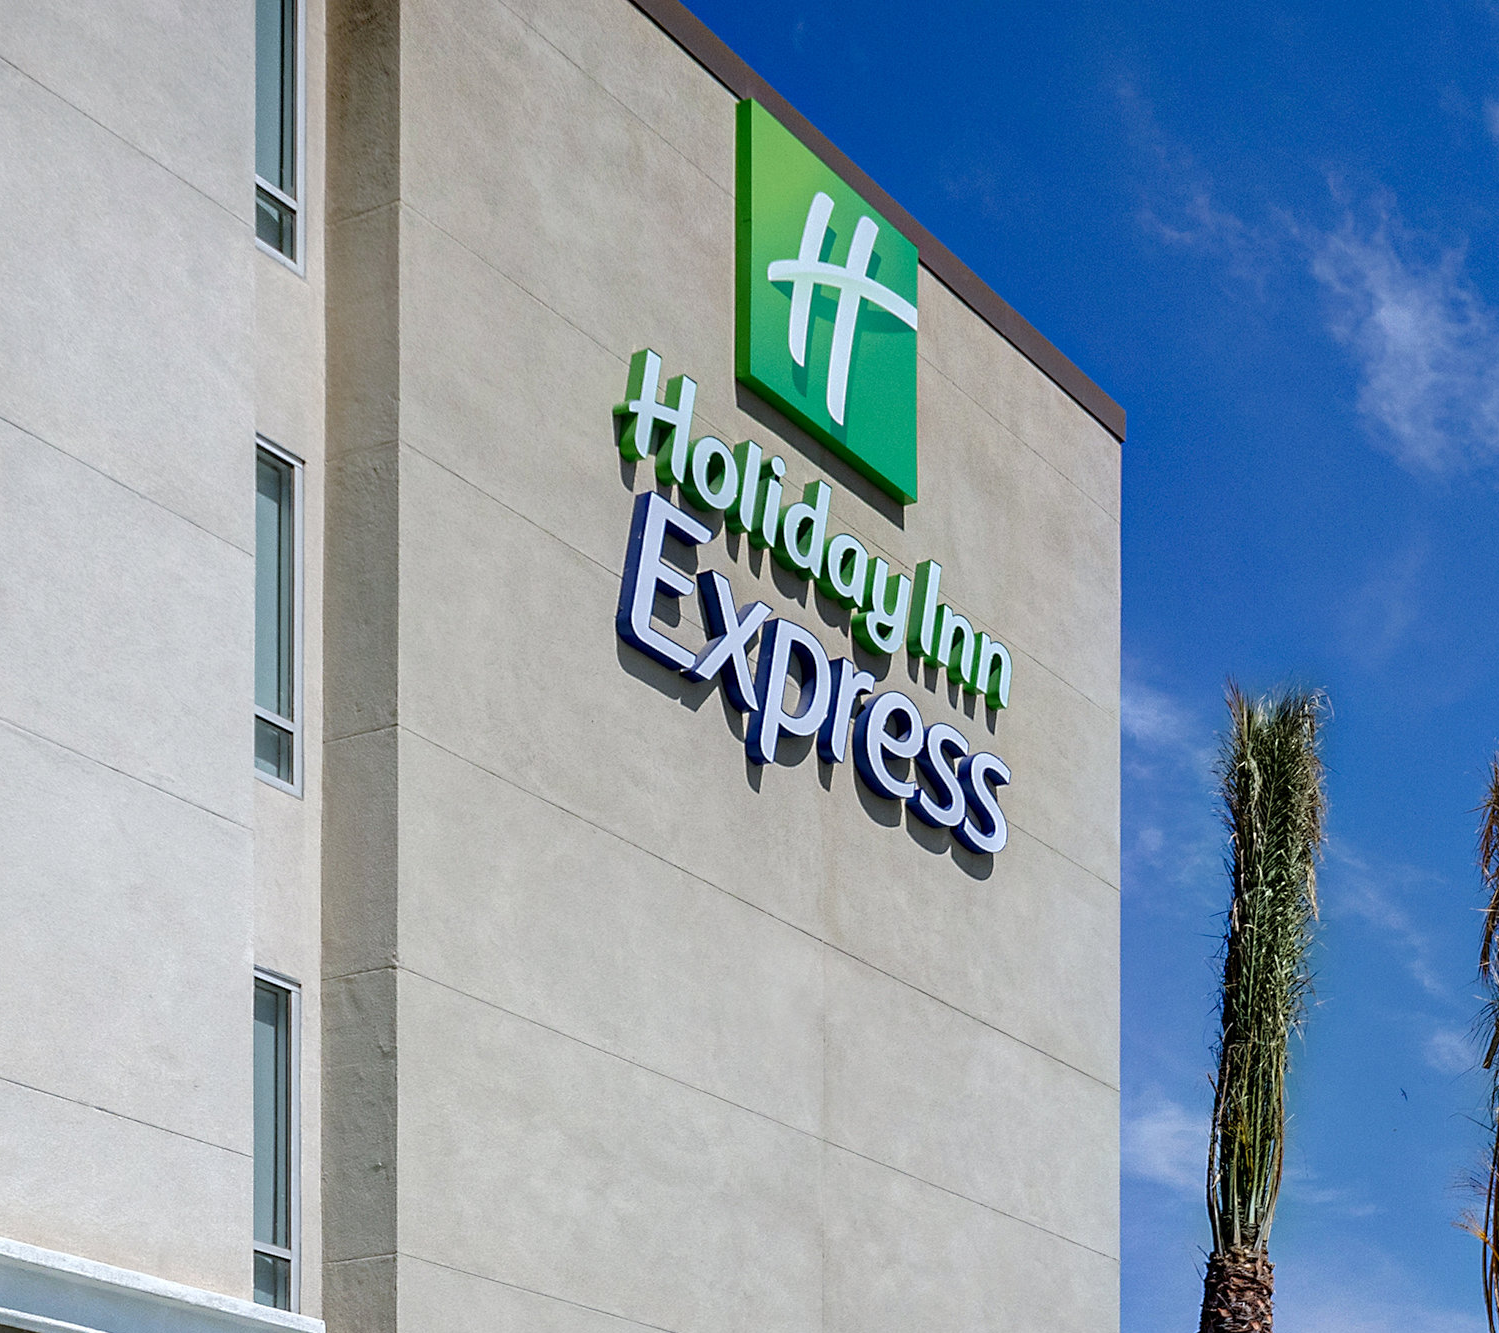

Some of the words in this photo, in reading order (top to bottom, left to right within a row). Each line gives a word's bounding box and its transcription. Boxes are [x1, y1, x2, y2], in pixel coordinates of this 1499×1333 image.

[613, 347, 912, 656] Holiday
[907, 558, 1013, 711] Inn
[615, 490, 1012, 855] Express
